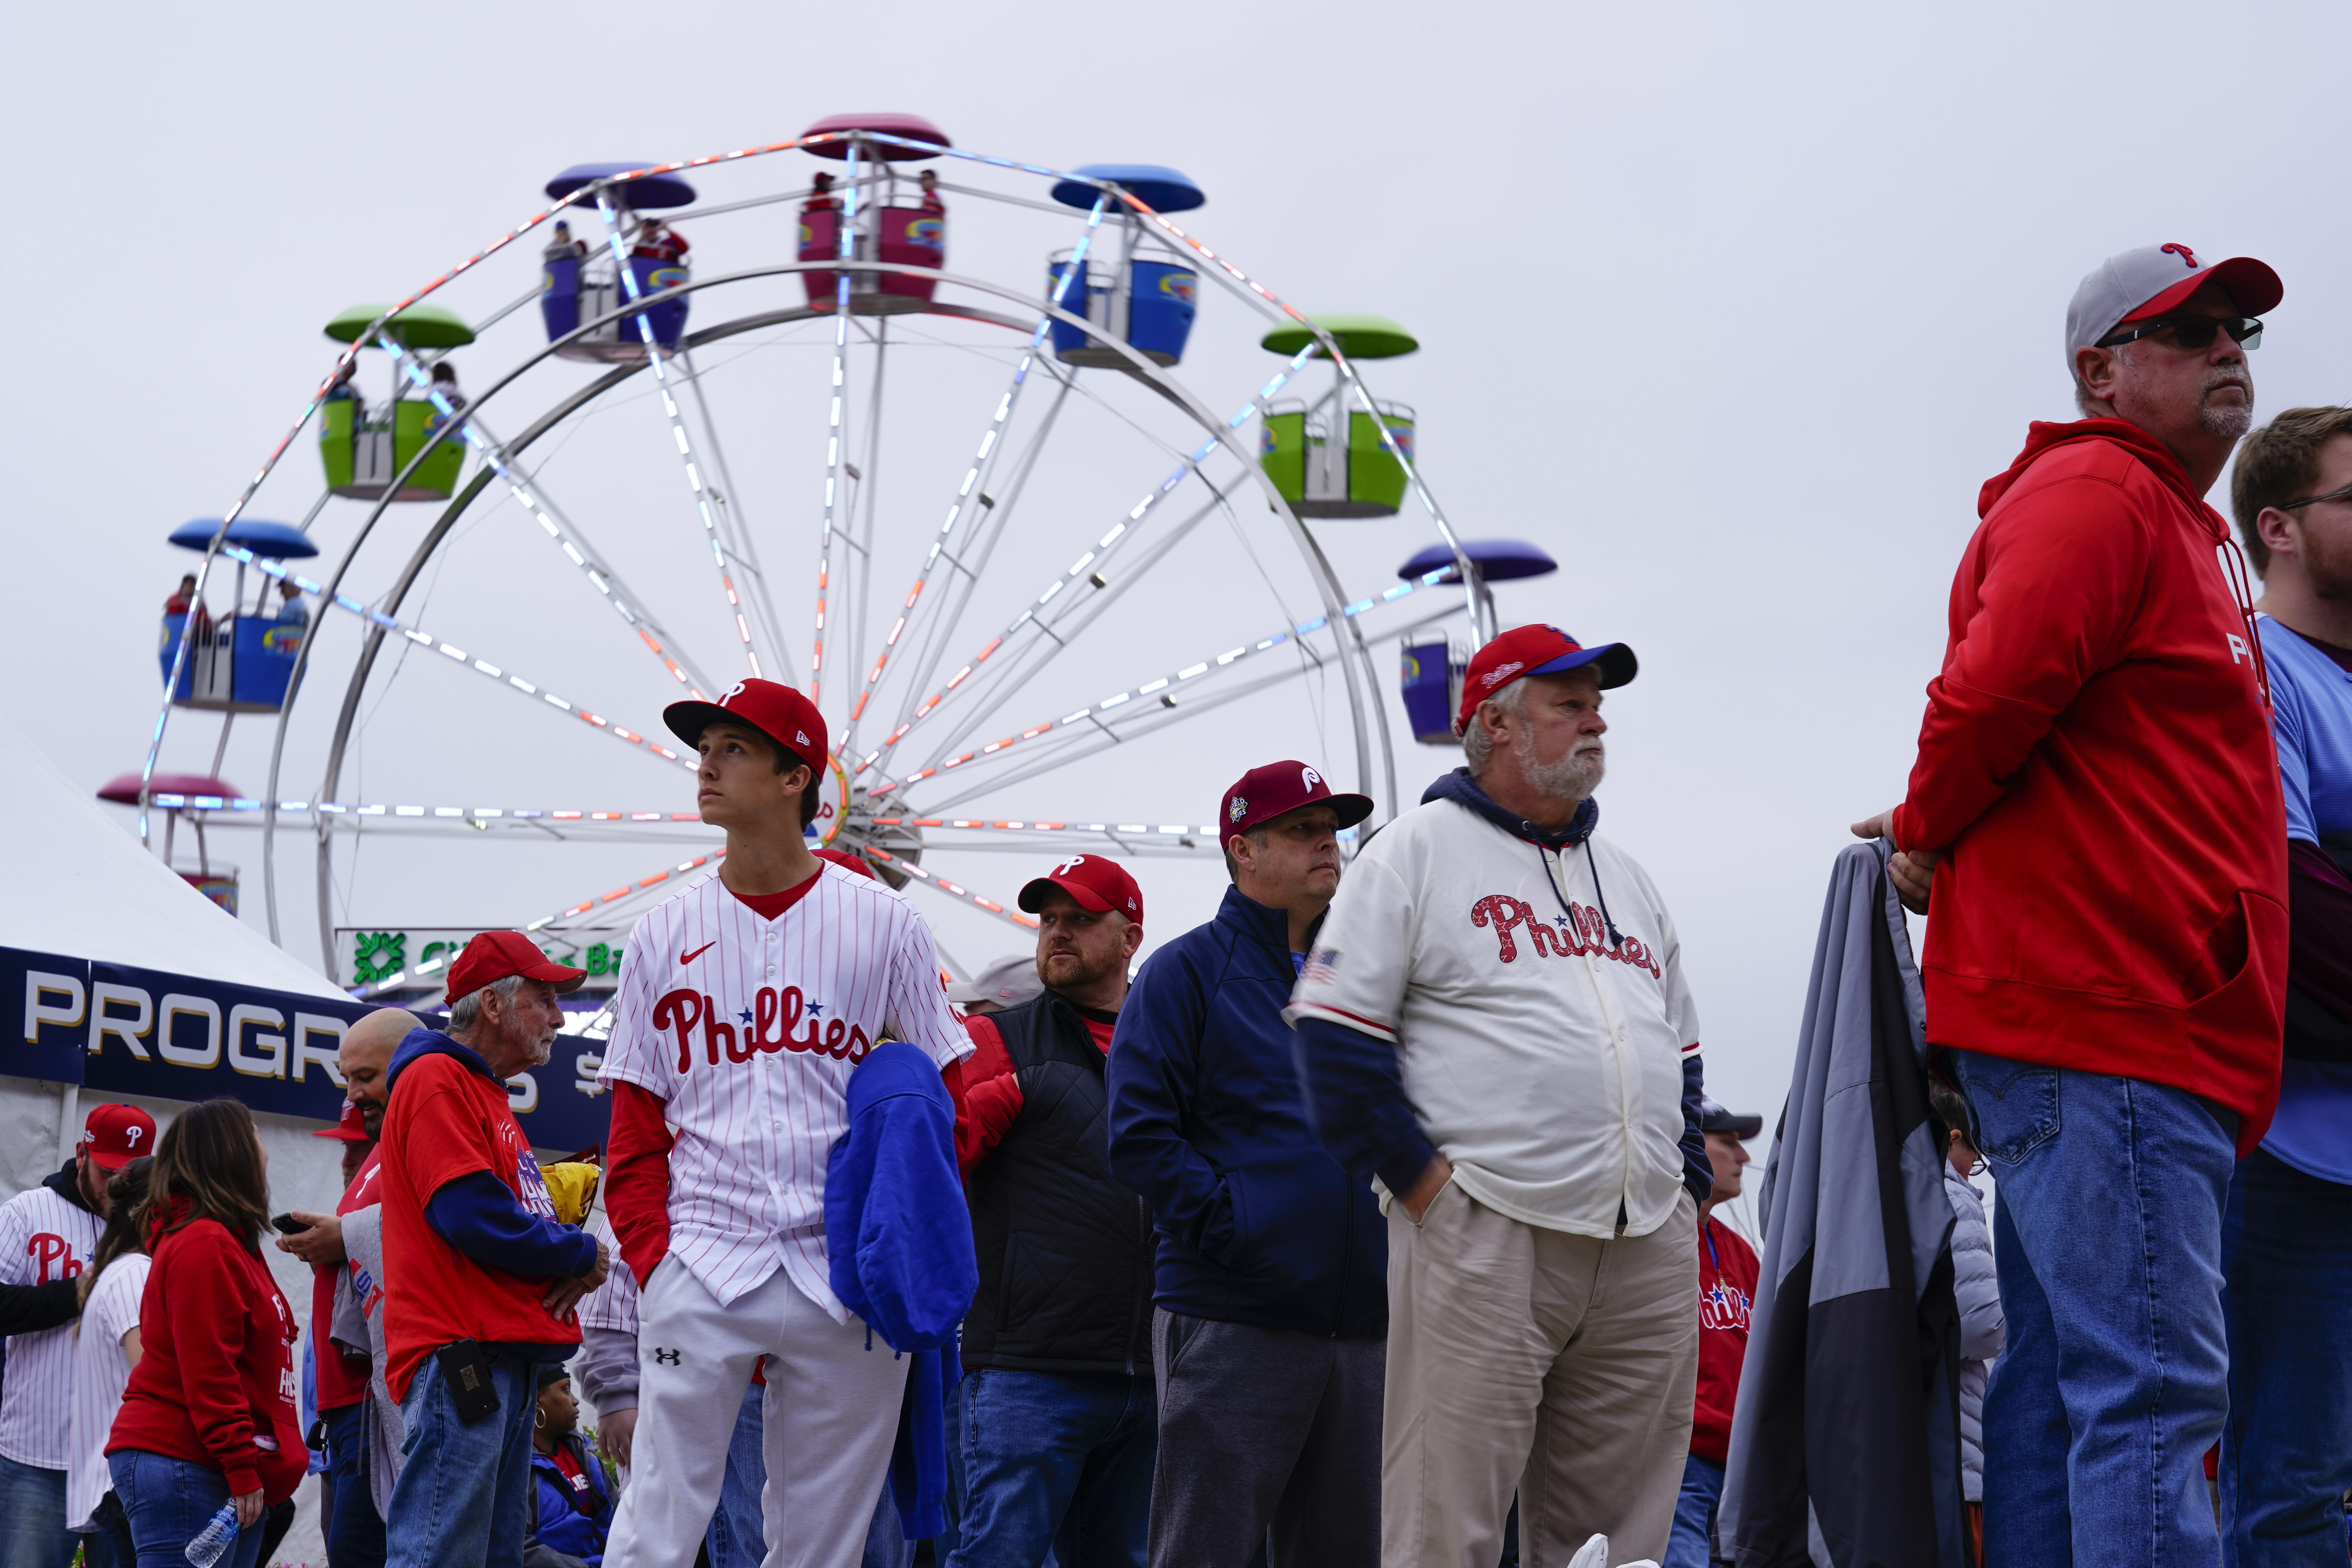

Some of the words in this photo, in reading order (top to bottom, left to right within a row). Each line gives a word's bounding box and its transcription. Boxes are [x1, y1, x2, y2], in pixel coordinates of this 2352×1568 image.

[720, 682, 745, 707] P
[1301, 767, 1320, 793] P
[1232, 809, 1246, 823] SERIES
[1062, 856, 1085, 875] P
[1471, 895, 1660, 980] Phillies
[652, 986, 870, 1075] Phillies
[126, 1126, 142, 1148] P
